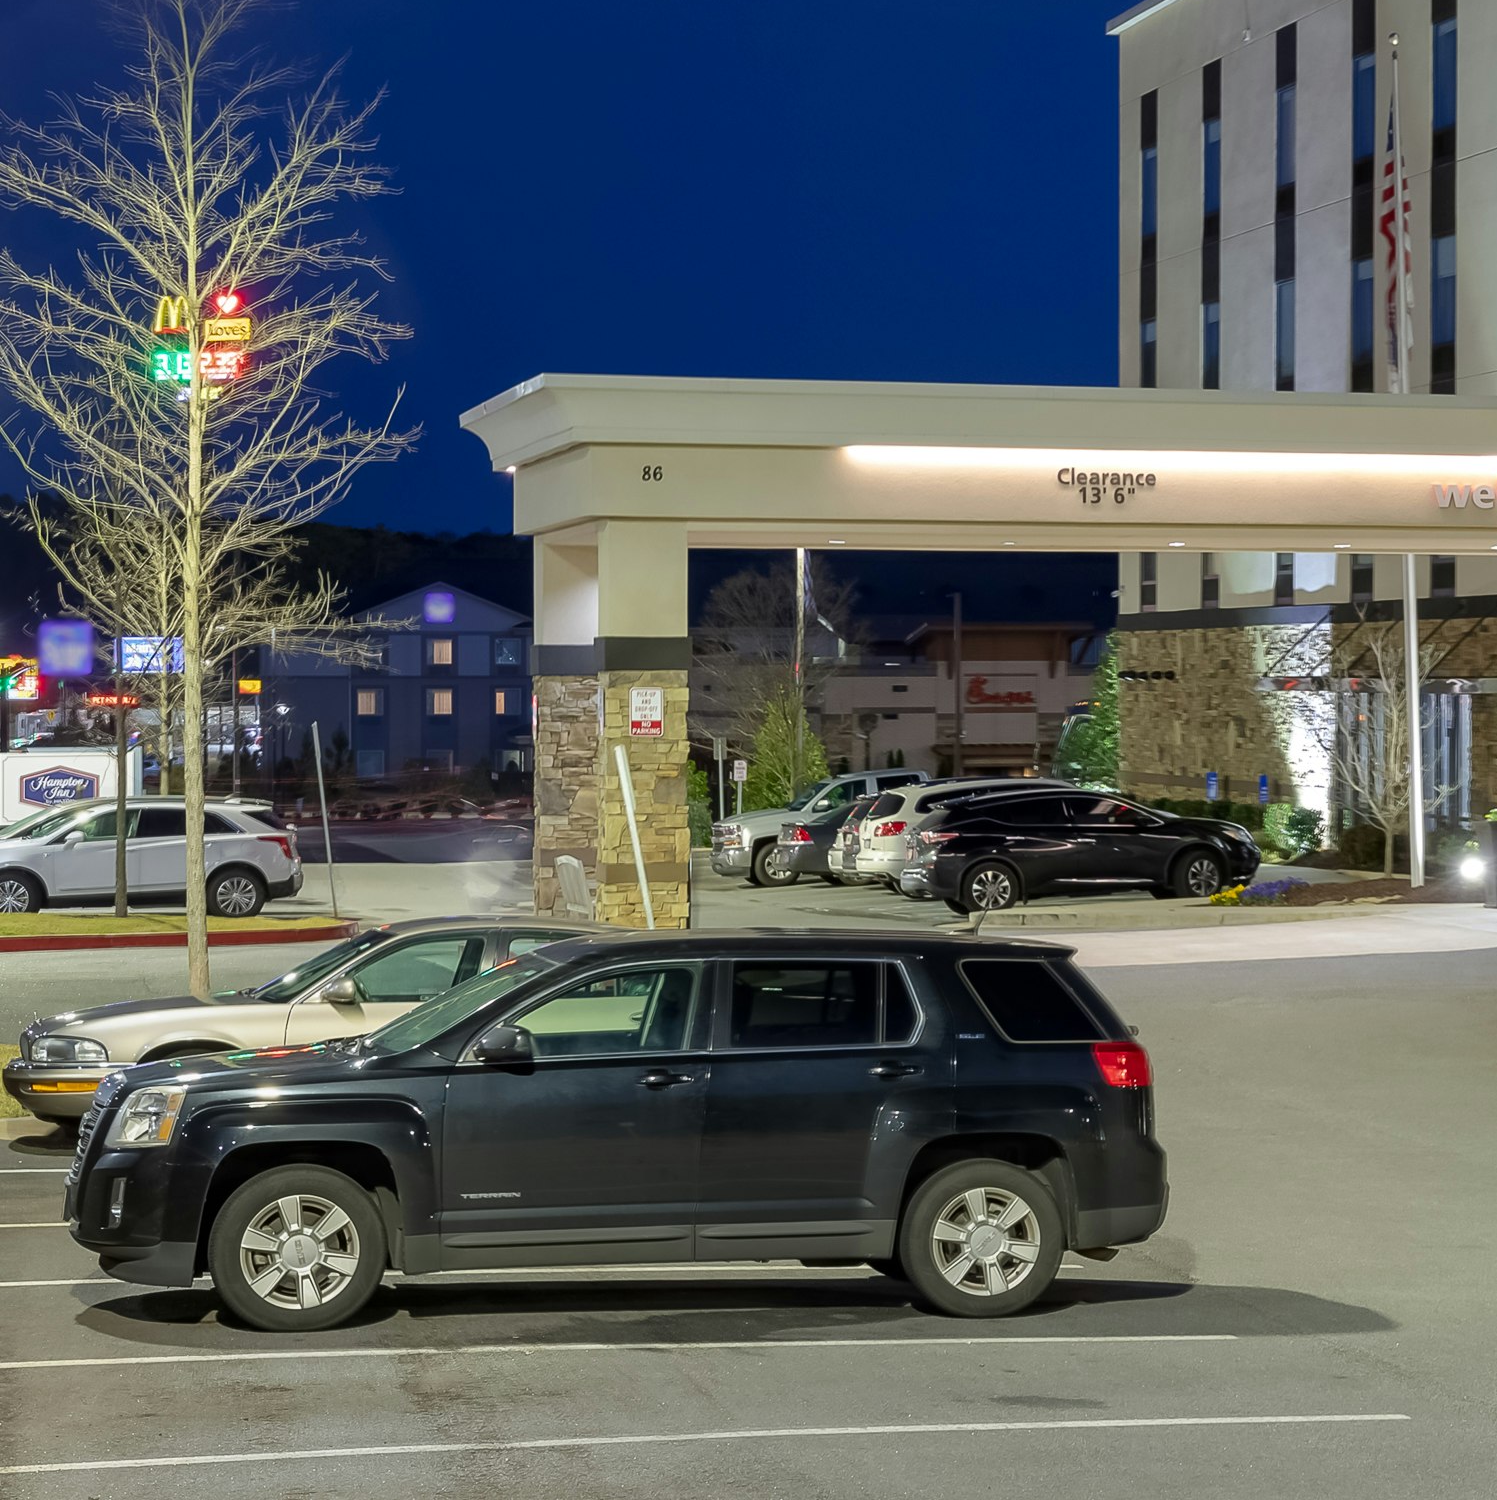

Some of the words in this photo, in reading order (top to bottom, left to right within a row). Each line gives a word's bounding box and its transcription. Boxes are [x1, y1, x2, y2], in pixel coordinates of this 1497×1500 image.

[642, 465, 663, 481] 86
[1057, 467, 1156, 486] Clearance
[1078, 487, 1107, 504] 13'
[1113, 487, 1135, 504] 6"
[632, 727, 661, 735] PARKING
[30, 775, 89, 791] Hampton
[43, 787, 76, 800] Inn
